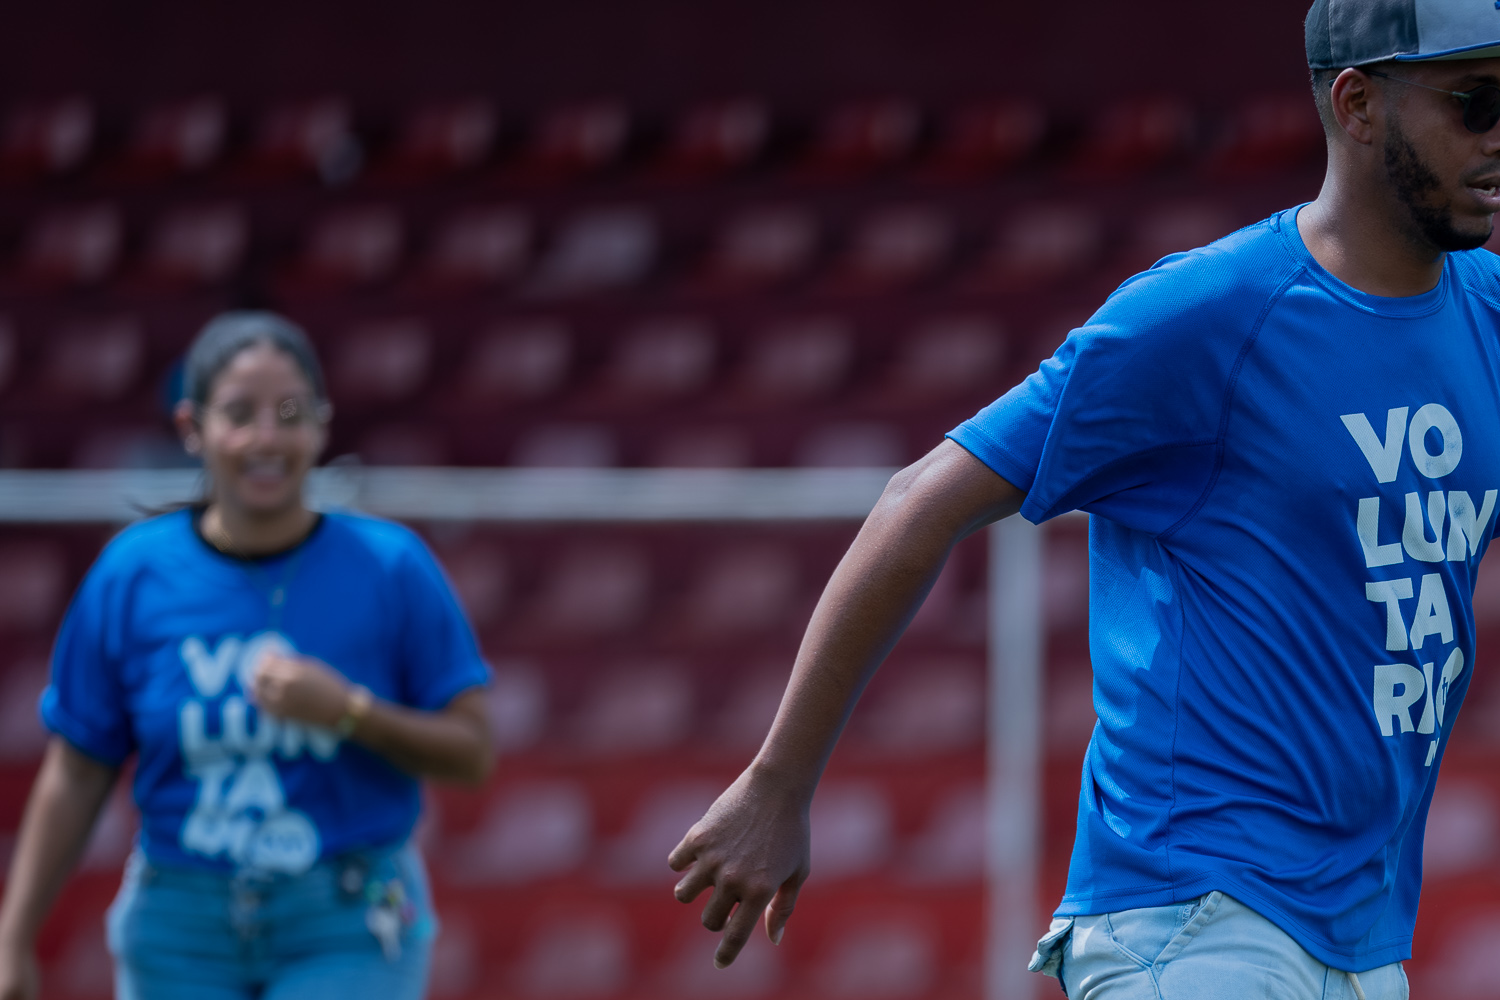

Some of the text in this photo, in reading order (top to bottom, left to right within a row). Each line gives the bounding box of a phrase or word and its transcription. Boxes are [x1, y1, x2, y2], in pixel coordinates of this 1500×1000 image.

[1340, 403, 1463, 484] VO
[1356, 489, 1498, 568] LUN
[1366, 573, 1454, 651] TA
